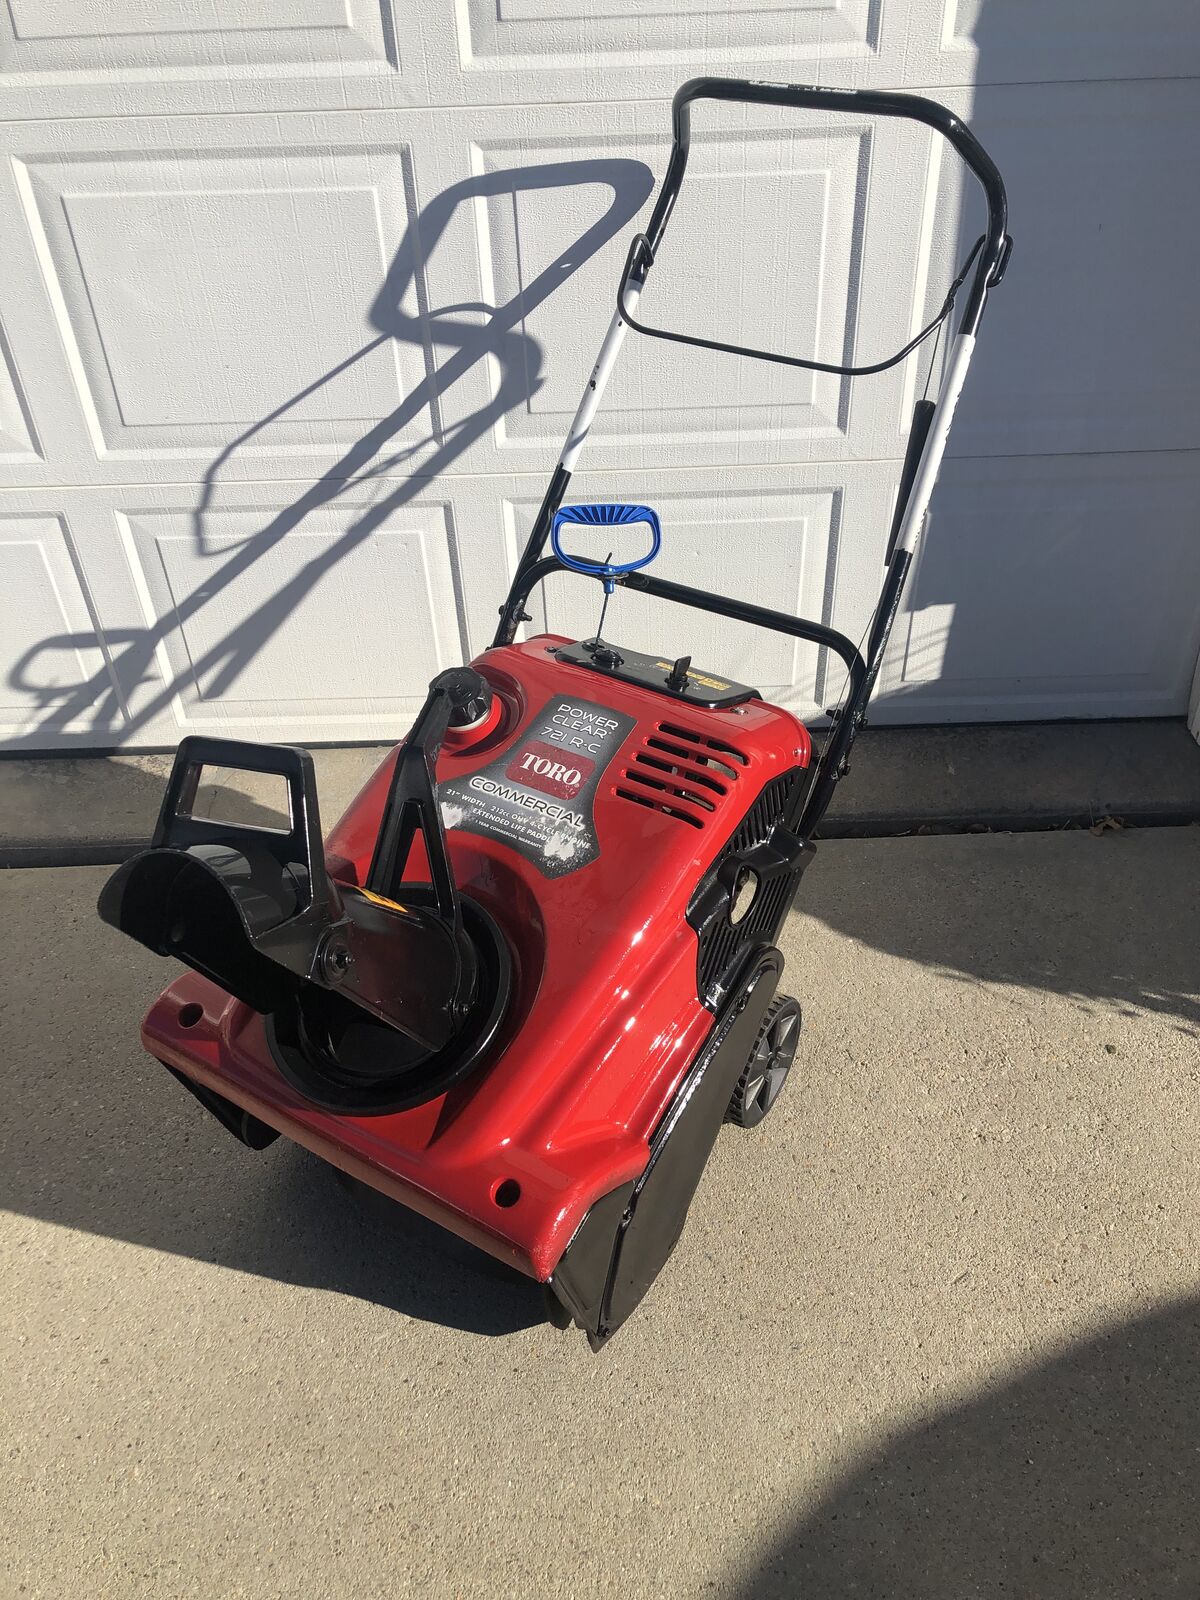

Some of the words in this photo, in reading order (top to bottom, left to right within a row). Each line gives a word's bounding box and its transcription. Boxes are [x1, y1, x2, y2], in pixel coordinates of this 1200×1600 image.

[552, 714, 608, 739] CLEAR
[557, 703, 619, 731] POWER
[541, 726, 568, 742] 721
[569, 736, 601, 754] R-C
[520, 752, 581, 785] TORO
[461, 794, 486, 808] WIDTH
[490, 805, 509, 818] 212cc
[511, 813, 529, 824] OHV
[530, 821, 560, 836] 4-CYCLE
[470, 776, 585, 831] COMMERCIAL
[472, 808, 510, 826] EXTENDED
[510, 822, 526, 833] LIFE
[526, 829, 556, 844] PADDL
[489, 825, 518, 840] COMMERCIAL
[518, 836, 543, 849] WARRANTY
